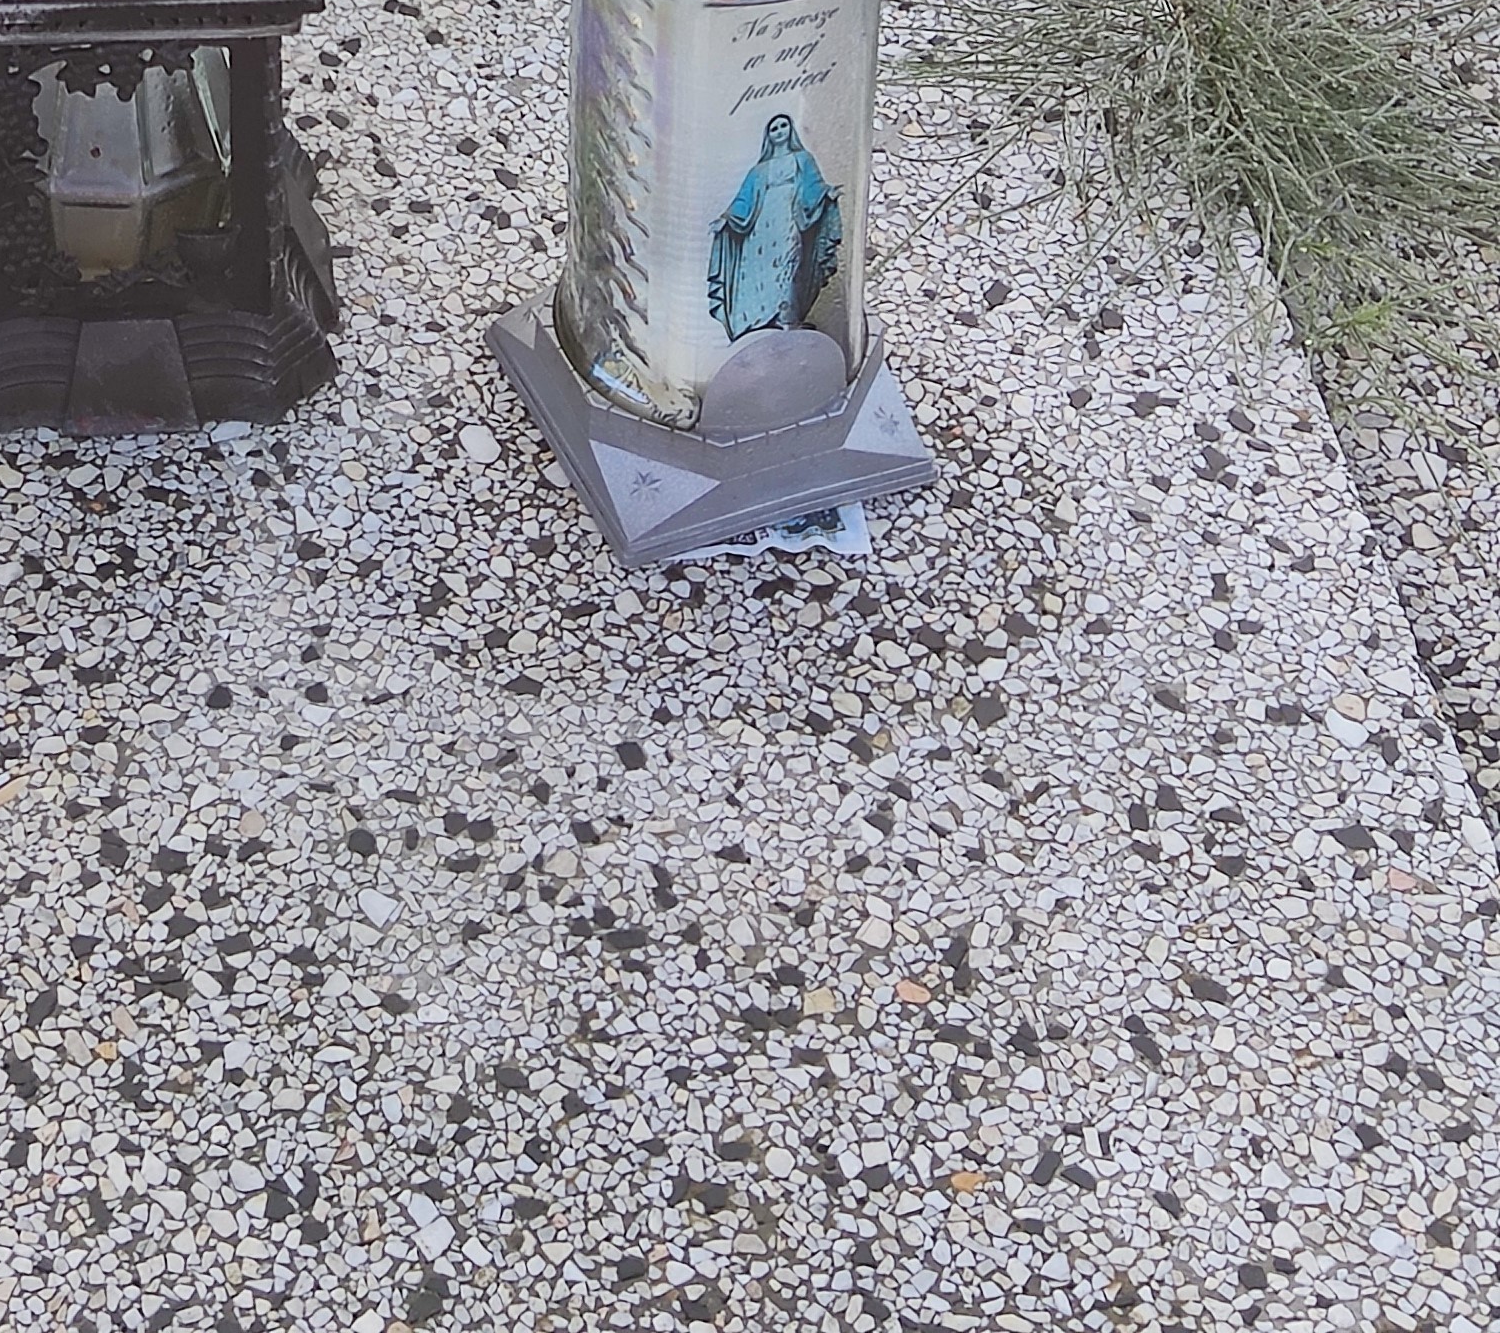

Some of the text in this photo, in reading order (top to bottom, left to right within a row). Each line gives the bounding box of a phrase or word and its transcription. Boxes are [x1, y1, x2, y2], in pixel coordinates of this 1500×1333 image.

[732, 7, 840, 43] Na zawsze
[743, 33, 825, 71] w mej
